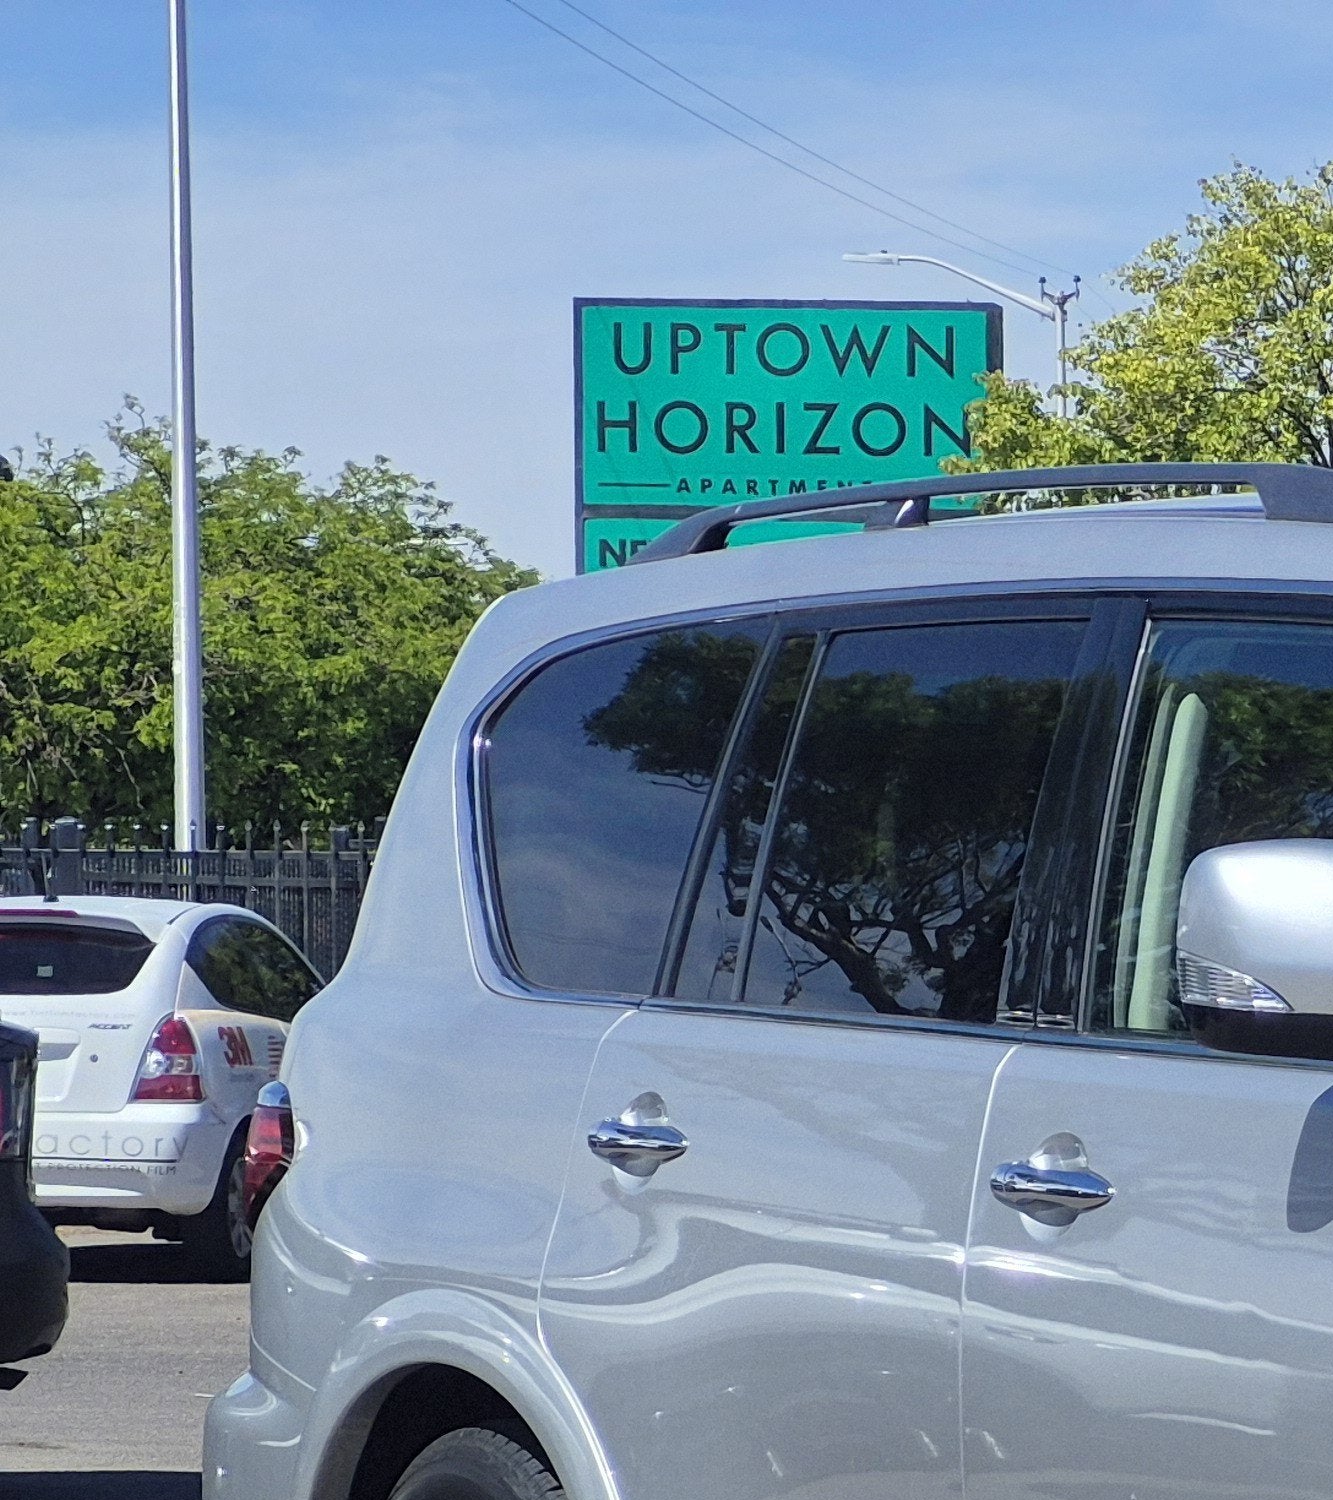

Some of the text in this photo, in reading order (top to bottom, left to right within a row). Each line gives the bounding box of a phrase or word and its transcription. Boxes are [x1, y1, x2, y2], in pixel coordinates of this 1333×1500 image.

[613, 321, 956, 378] UPTOWN
[595, 401, 972, 457] HORIZON
[676, 477, 872, 496] APARTME
[217, 1026, 254, 1068] 3M
[35, 1130, 189, 1161] actory
